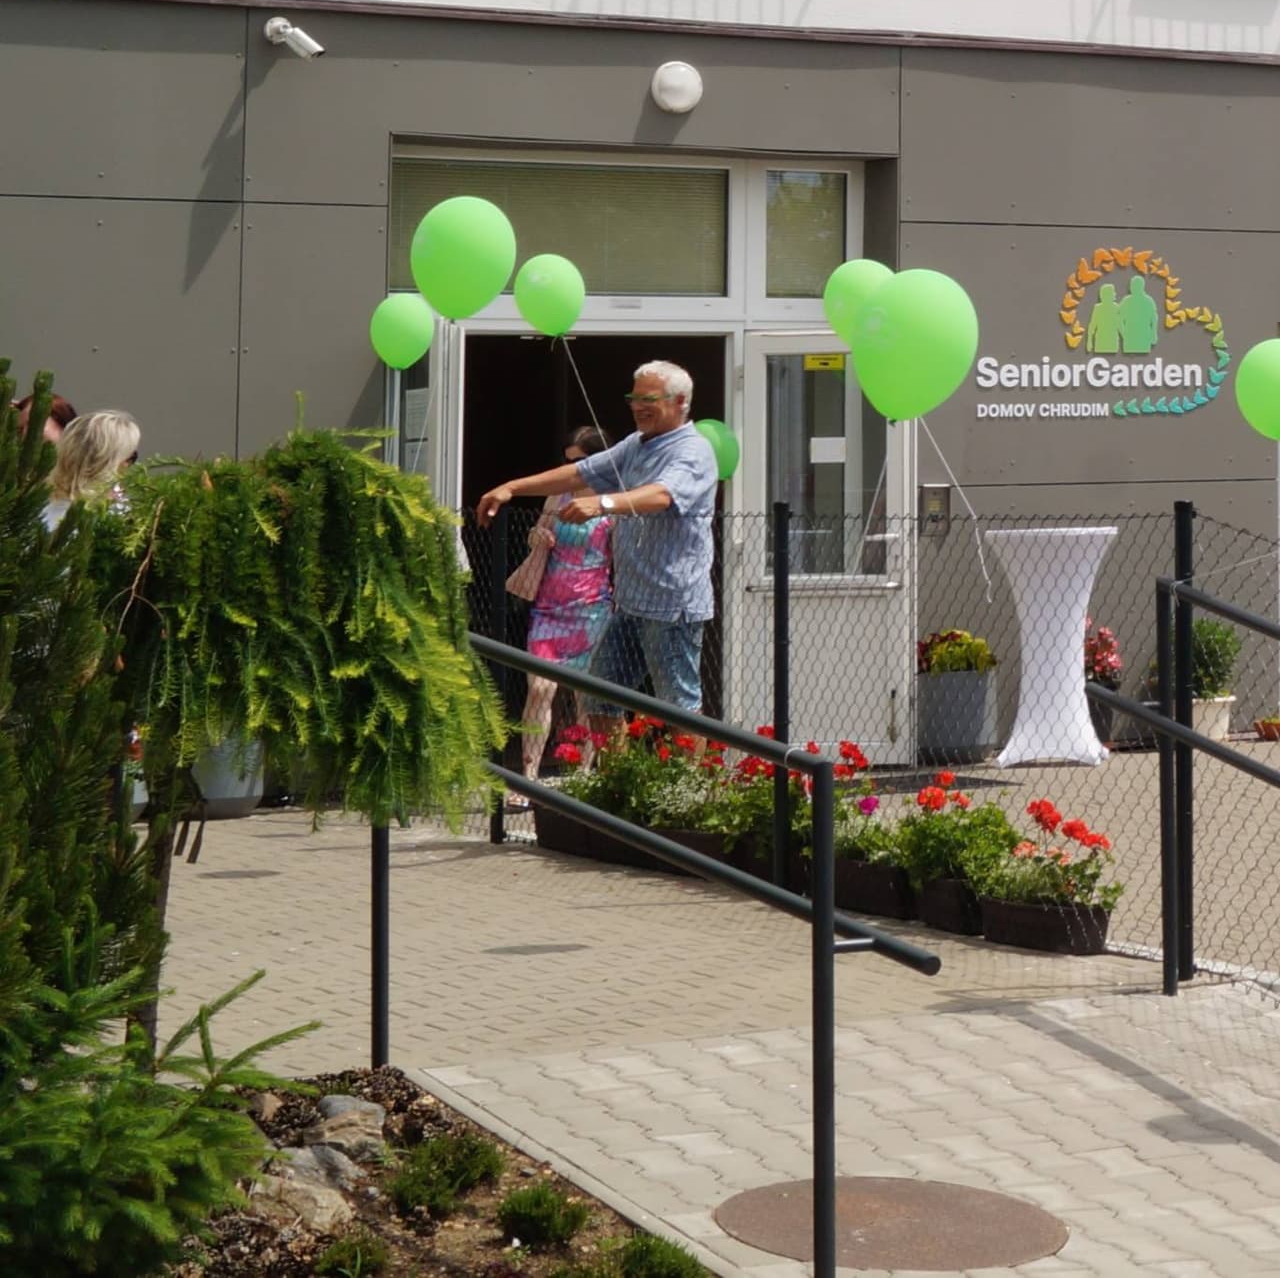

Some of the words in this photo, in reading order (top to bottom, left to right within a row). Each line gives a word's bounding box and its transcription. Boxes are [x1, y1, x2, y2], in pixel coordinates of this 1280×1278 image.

[975, 355, 1202, 389] SeniorGarden
[976, 403, 1036, 418] DOMOV
[1039, 402, 1109, 418] CHRUDIM
